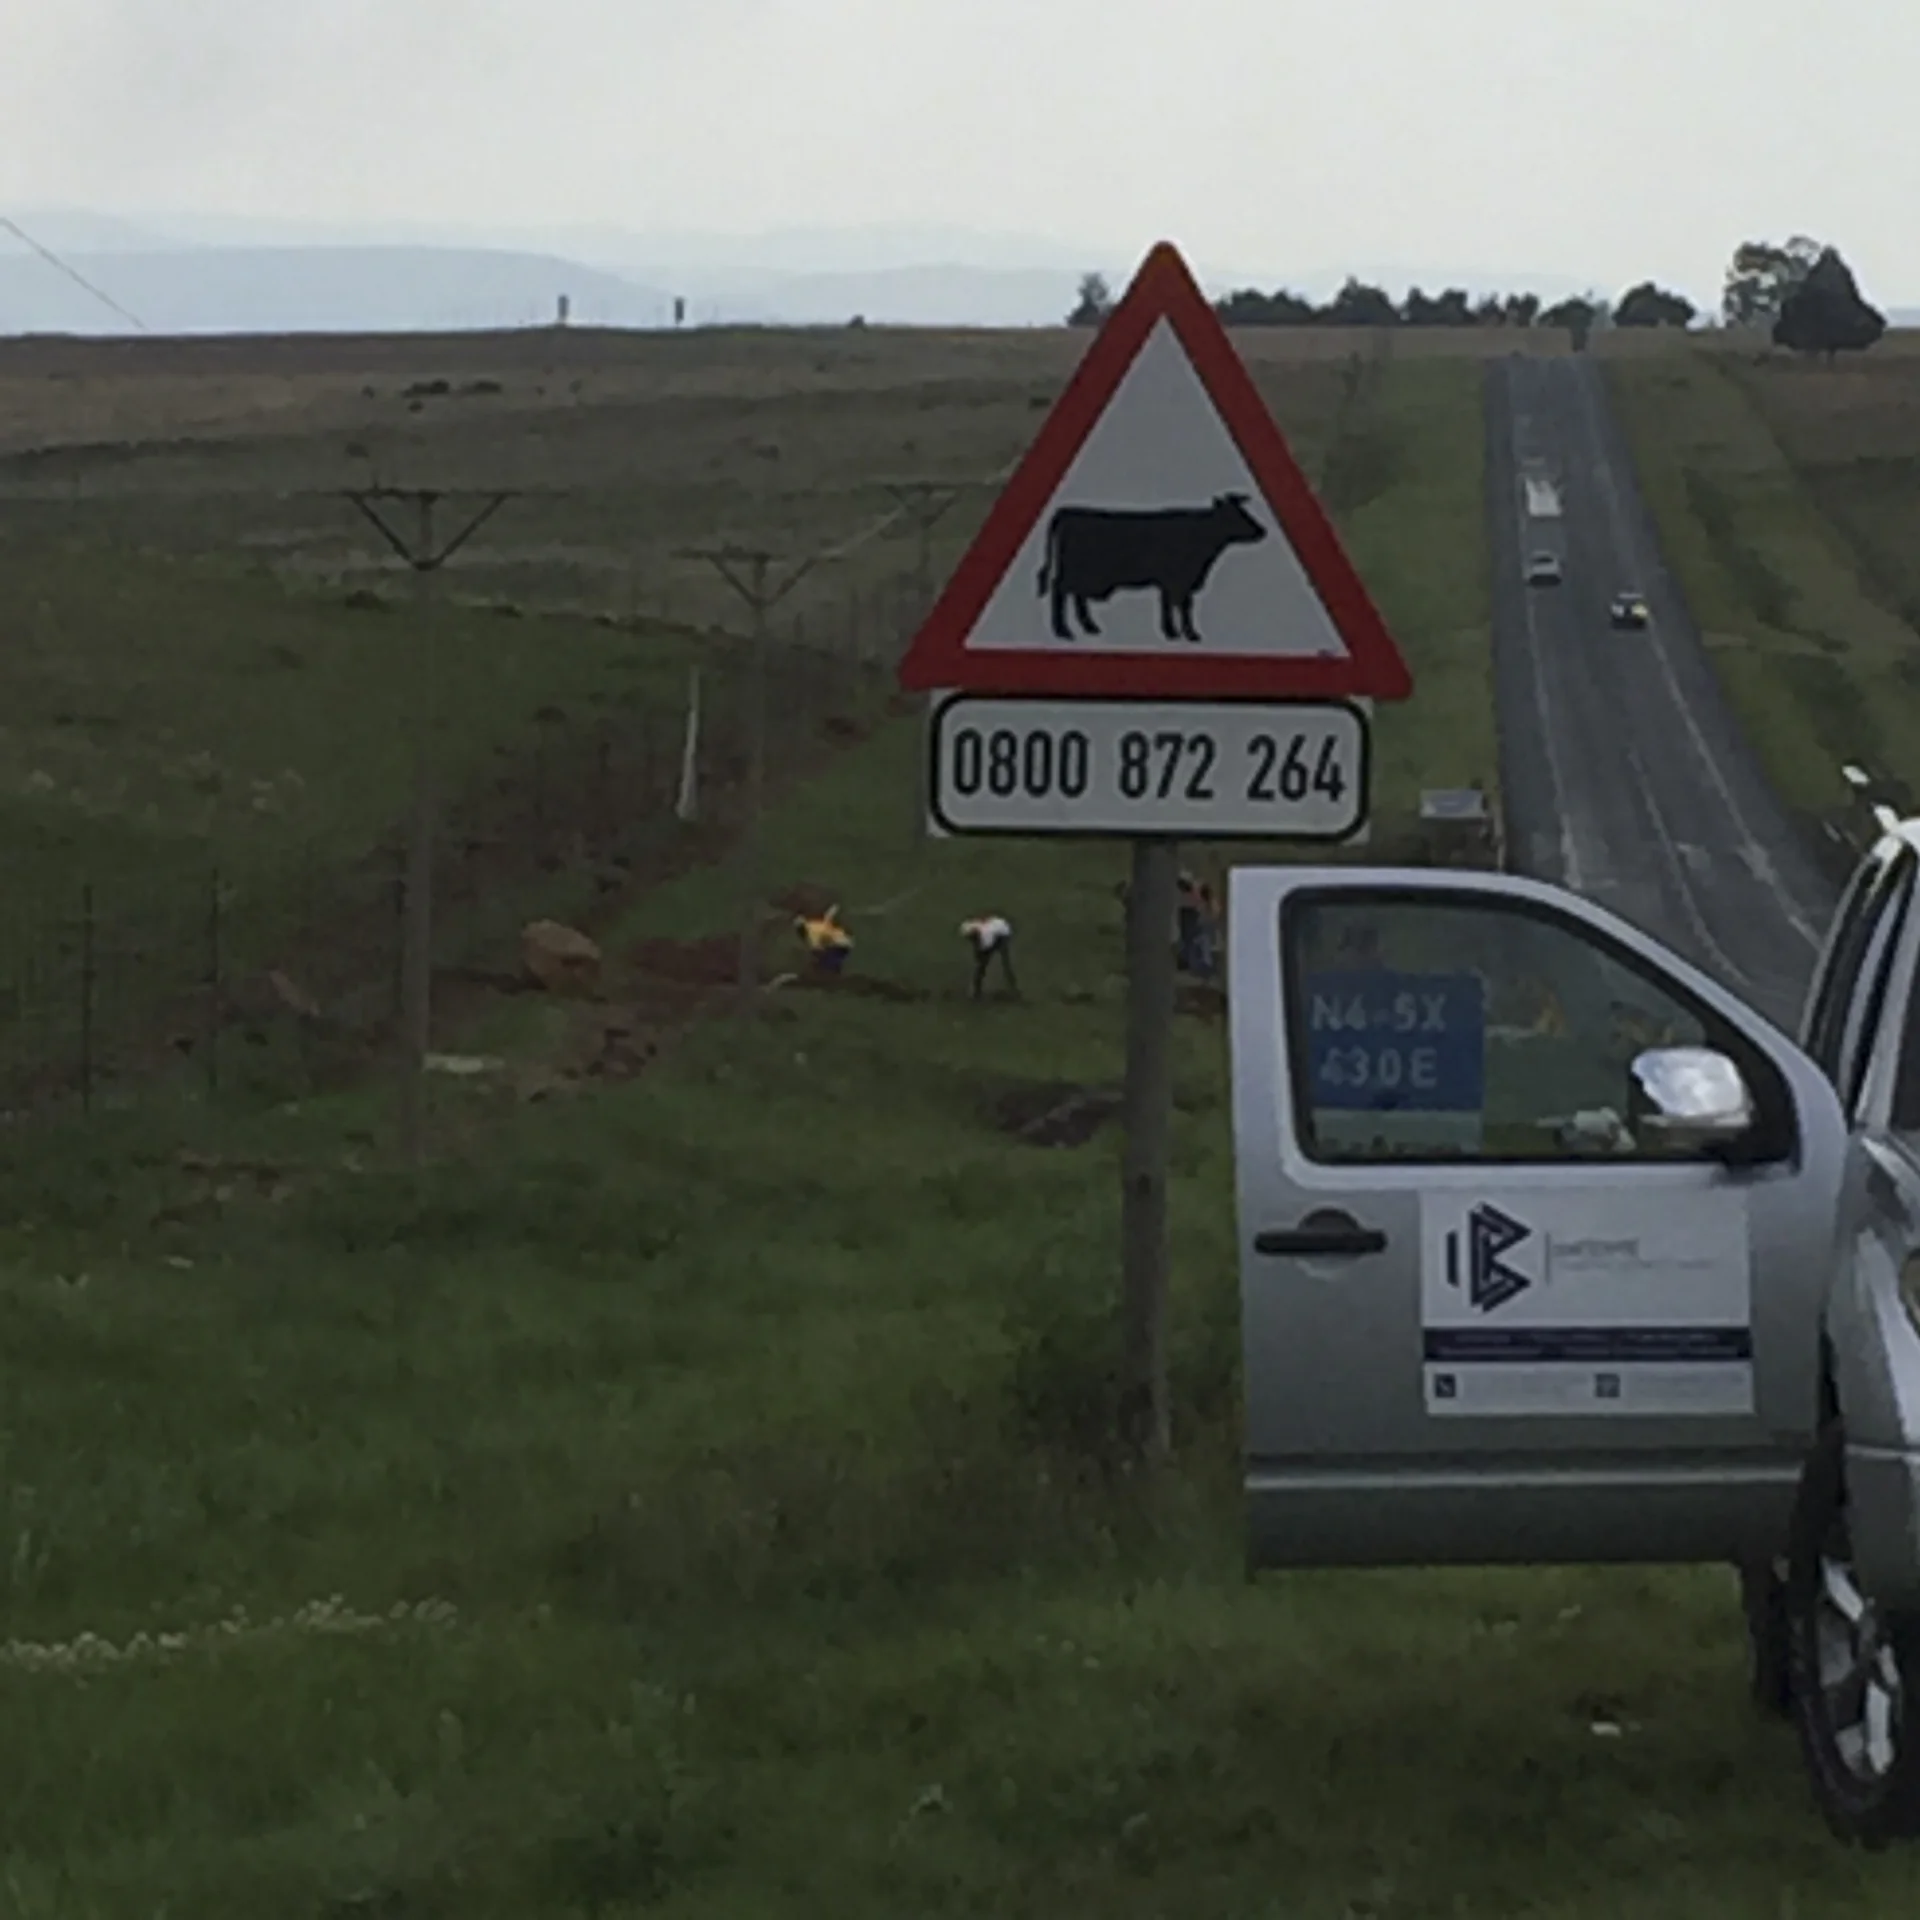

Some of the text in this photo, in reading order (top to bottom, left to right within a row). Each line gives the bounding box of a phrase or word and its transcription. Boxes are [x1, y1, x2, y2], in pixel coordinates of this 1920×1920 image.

[953, 728, 1346, 801] 0800 872 264
